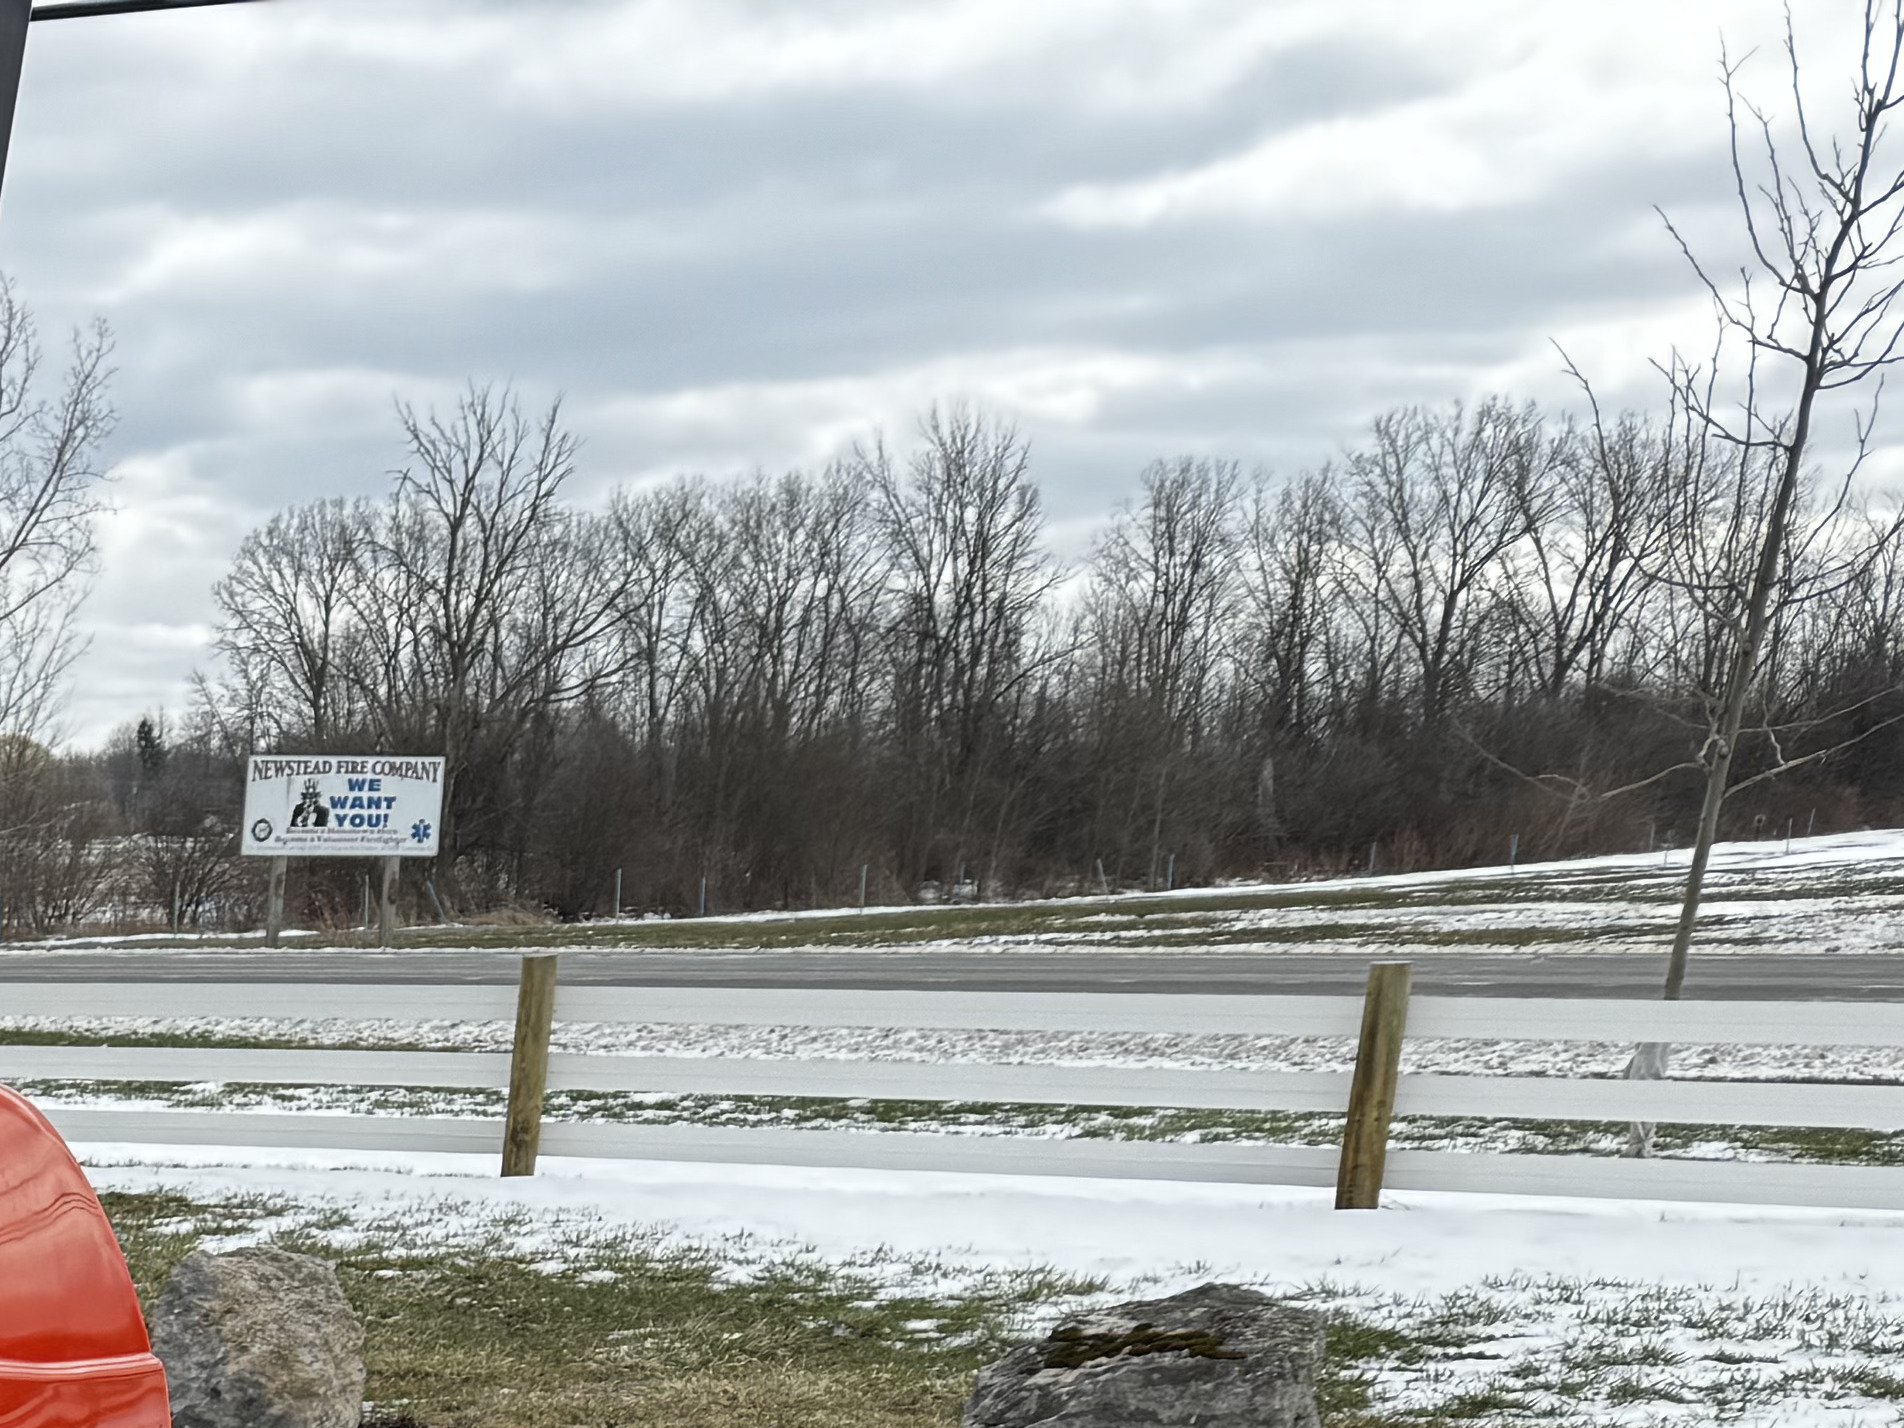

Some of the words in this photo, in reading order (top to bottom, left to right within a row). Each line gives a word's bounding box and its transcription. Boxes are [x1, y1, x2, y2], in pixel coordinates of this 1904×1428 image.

[252, 760, 332, 782] NEWSTEAD
[336, 760, 369, 775] FIRE
[371, 760, 441, 783] COMPANY
[347, 778, 382, 792] WE
[329, 796, 397, 810] WANT
[334, 813, 389, 829] YOU!
